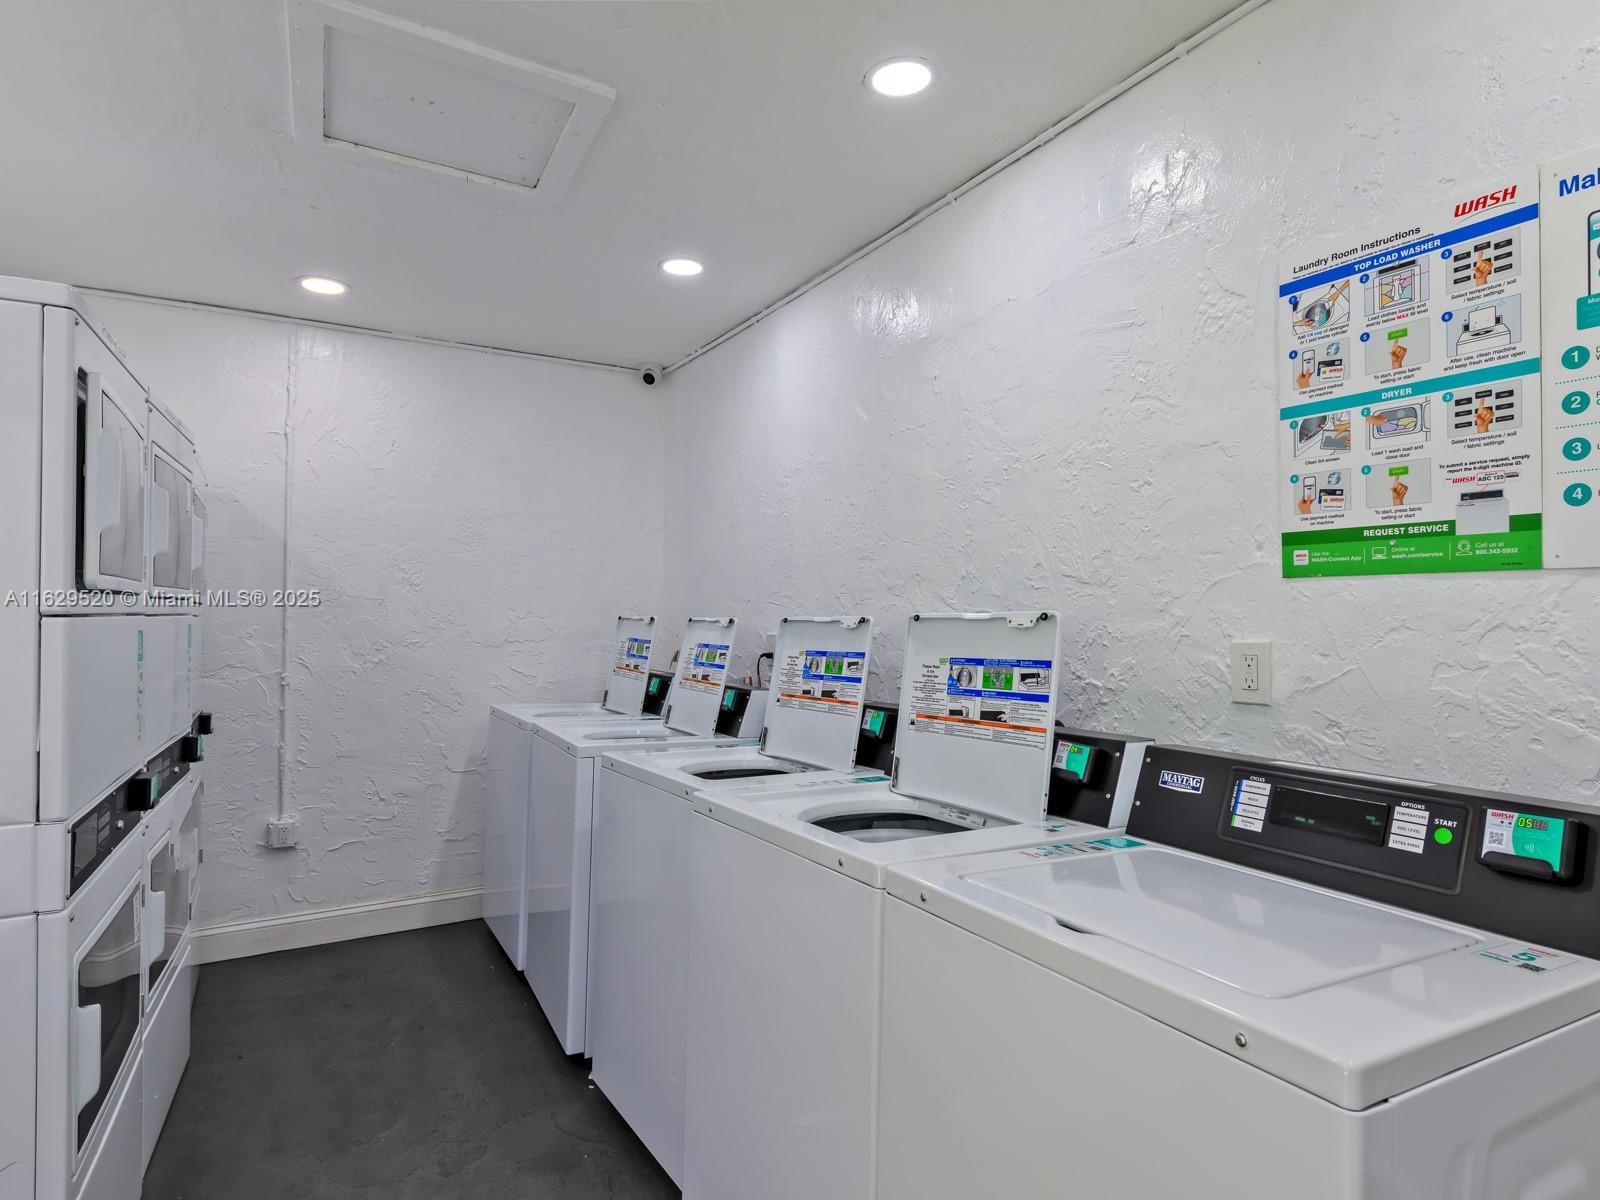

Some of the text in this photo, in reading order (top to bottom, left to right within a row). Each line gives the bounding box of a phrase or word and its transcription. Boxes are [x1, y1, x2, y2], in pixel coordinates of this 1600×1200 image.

[1559, 167, 1600, 197] Ma
[1454, 185, 1517, 218] WASH
[1293, 227, 1421, 274] Laundry Room Instructions
[1354, 240, 1441, 272] TOP LOAD WASHER
[1451, 291, 1467, 300] Select
[1468, 283, 1502, 294] temperature
[1467, 294, 1482, 302] fabric
[1483, 289, 1504, 298] settings
[1328, 323, 1350, 332] detergent
[1330, 330, 1348, 338] cylinder
[1492, 346, 1516, 355] machine
[1572, 350, 1578, 362] 1
[1308, 386, 1326, 394] payment
[1381, 388, 1412, 400] DRYER
[1570, 396, 1582, 408] 2
[1468, 434, 1502, 442] temperature
[1572, 442, 1582, 455] 3
[1452, 476, 1476, 484] WASH
[1572, 488, 1583, 500] 4
[1364, 524, 1449, 537] REQUEST SERVICE
[1162, 772, 1201, 788] MAYTAG
[1250, 775, 1266, 783] CYCLES
[1401, 801, 1425, 810] OPTIONS
[1396, 811, 1427, 820] TEMPERATURE
[1491, 811, 1514, 820] WASH
[1434, 818, 1458, 828] START
